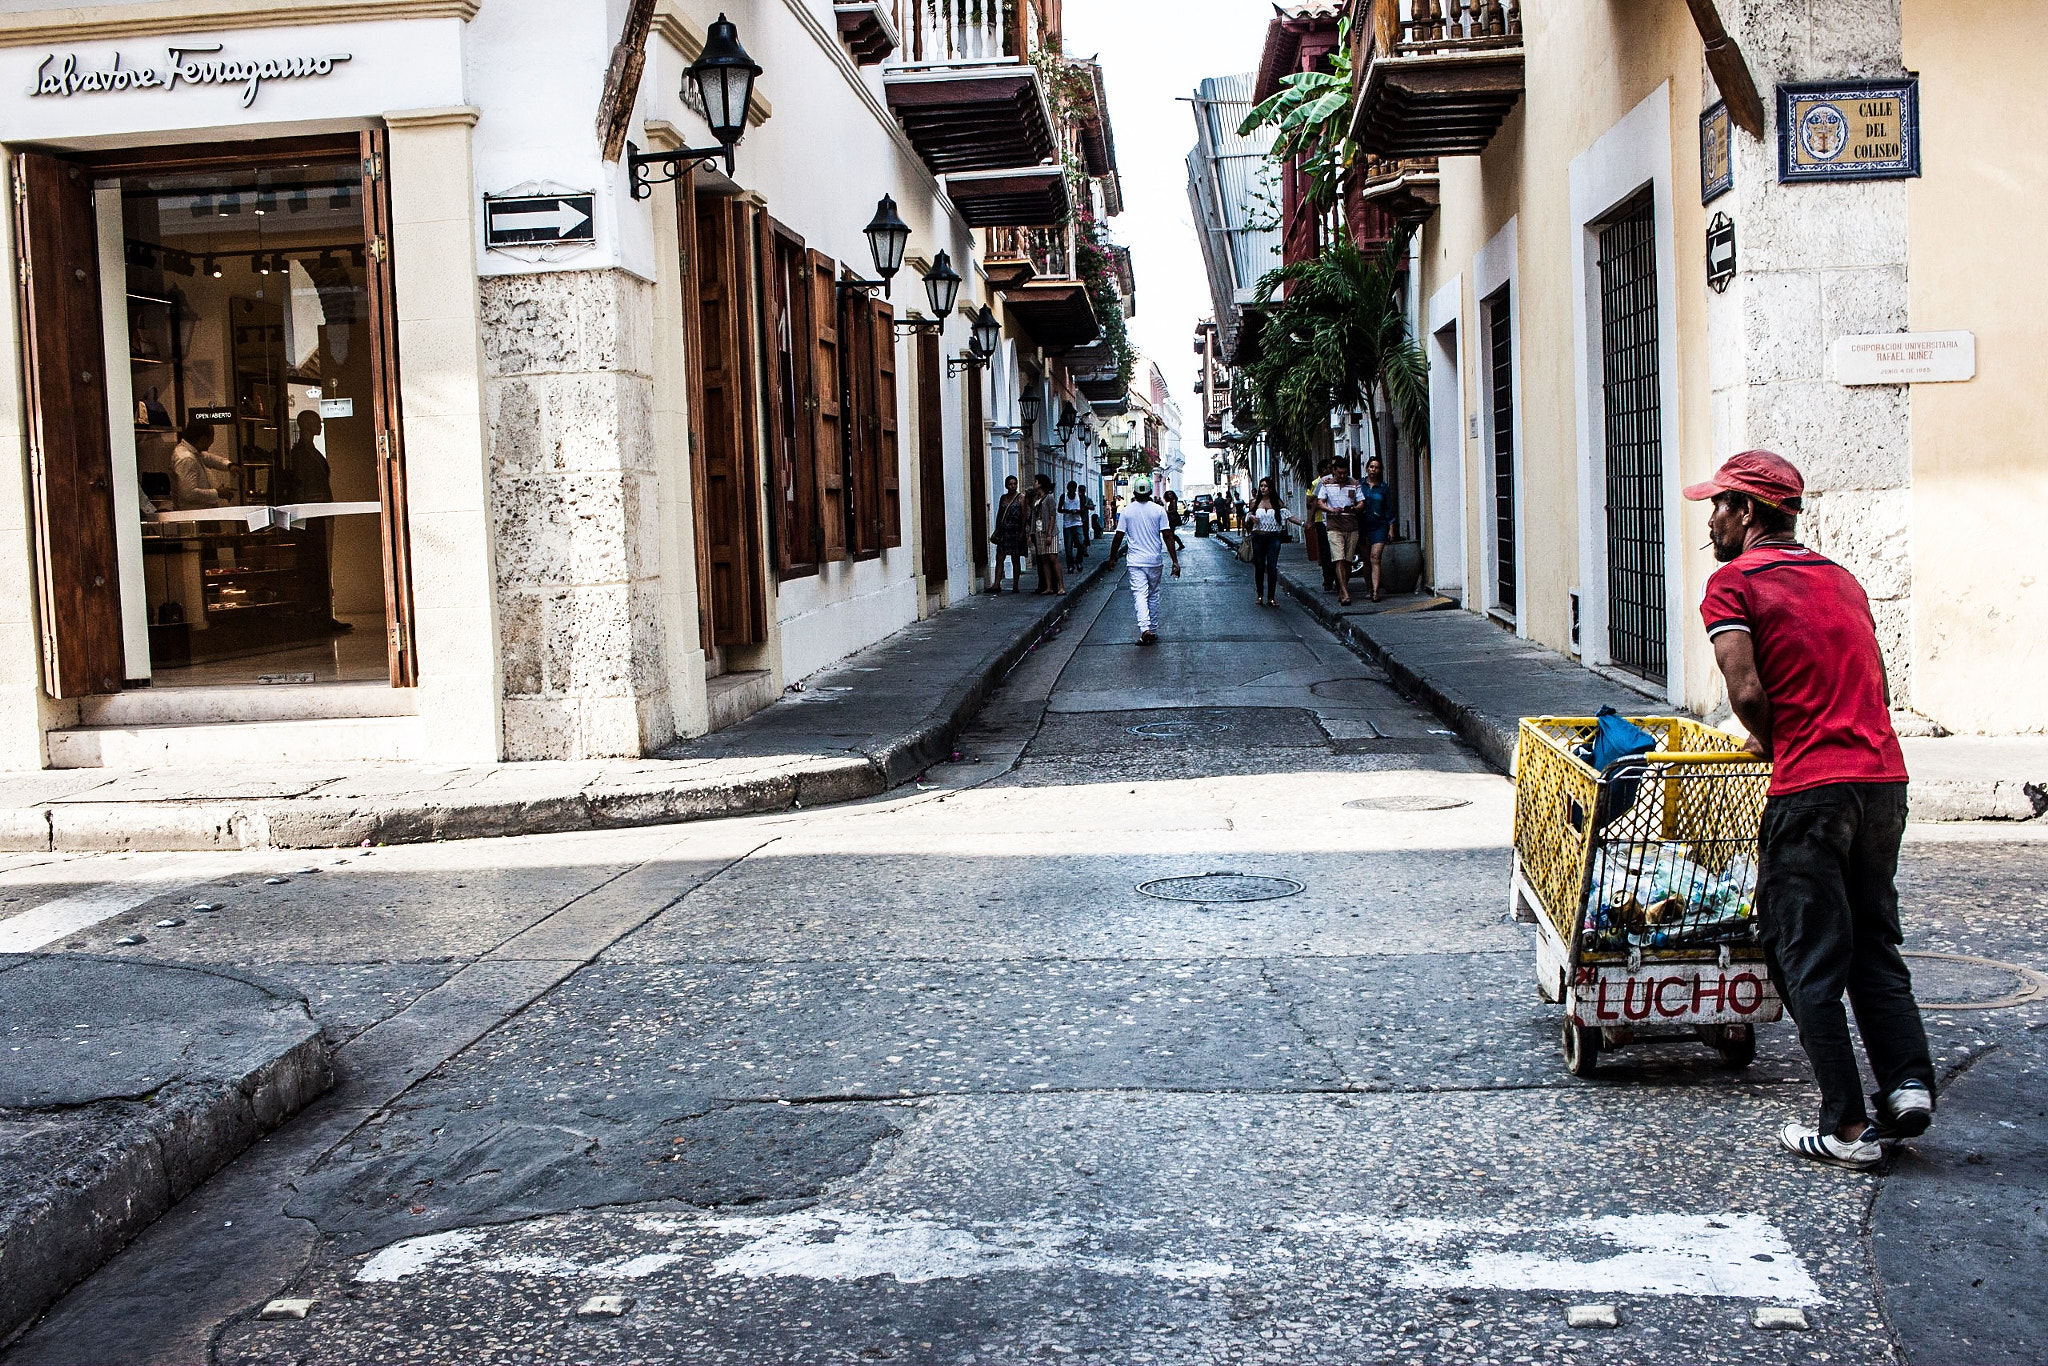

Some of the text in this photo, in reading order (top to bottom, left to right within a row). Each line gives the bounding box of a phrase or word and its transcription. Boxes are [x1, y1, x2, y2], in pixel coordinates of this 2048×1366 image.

[28, 42, 352, 108] Salvatore Ferragamo
[1859, 102, 1892, 117] CALLE
[1866, 123, 1886, 138] DEL
[1854, 143, 1899, 159] COLISEO
[1904, 340, 1959, 350] UNIVERSITARIA
[1876, 351, 1906, 361] RAFAEL
[1596, 972, 1763, 1020] LUCHO
